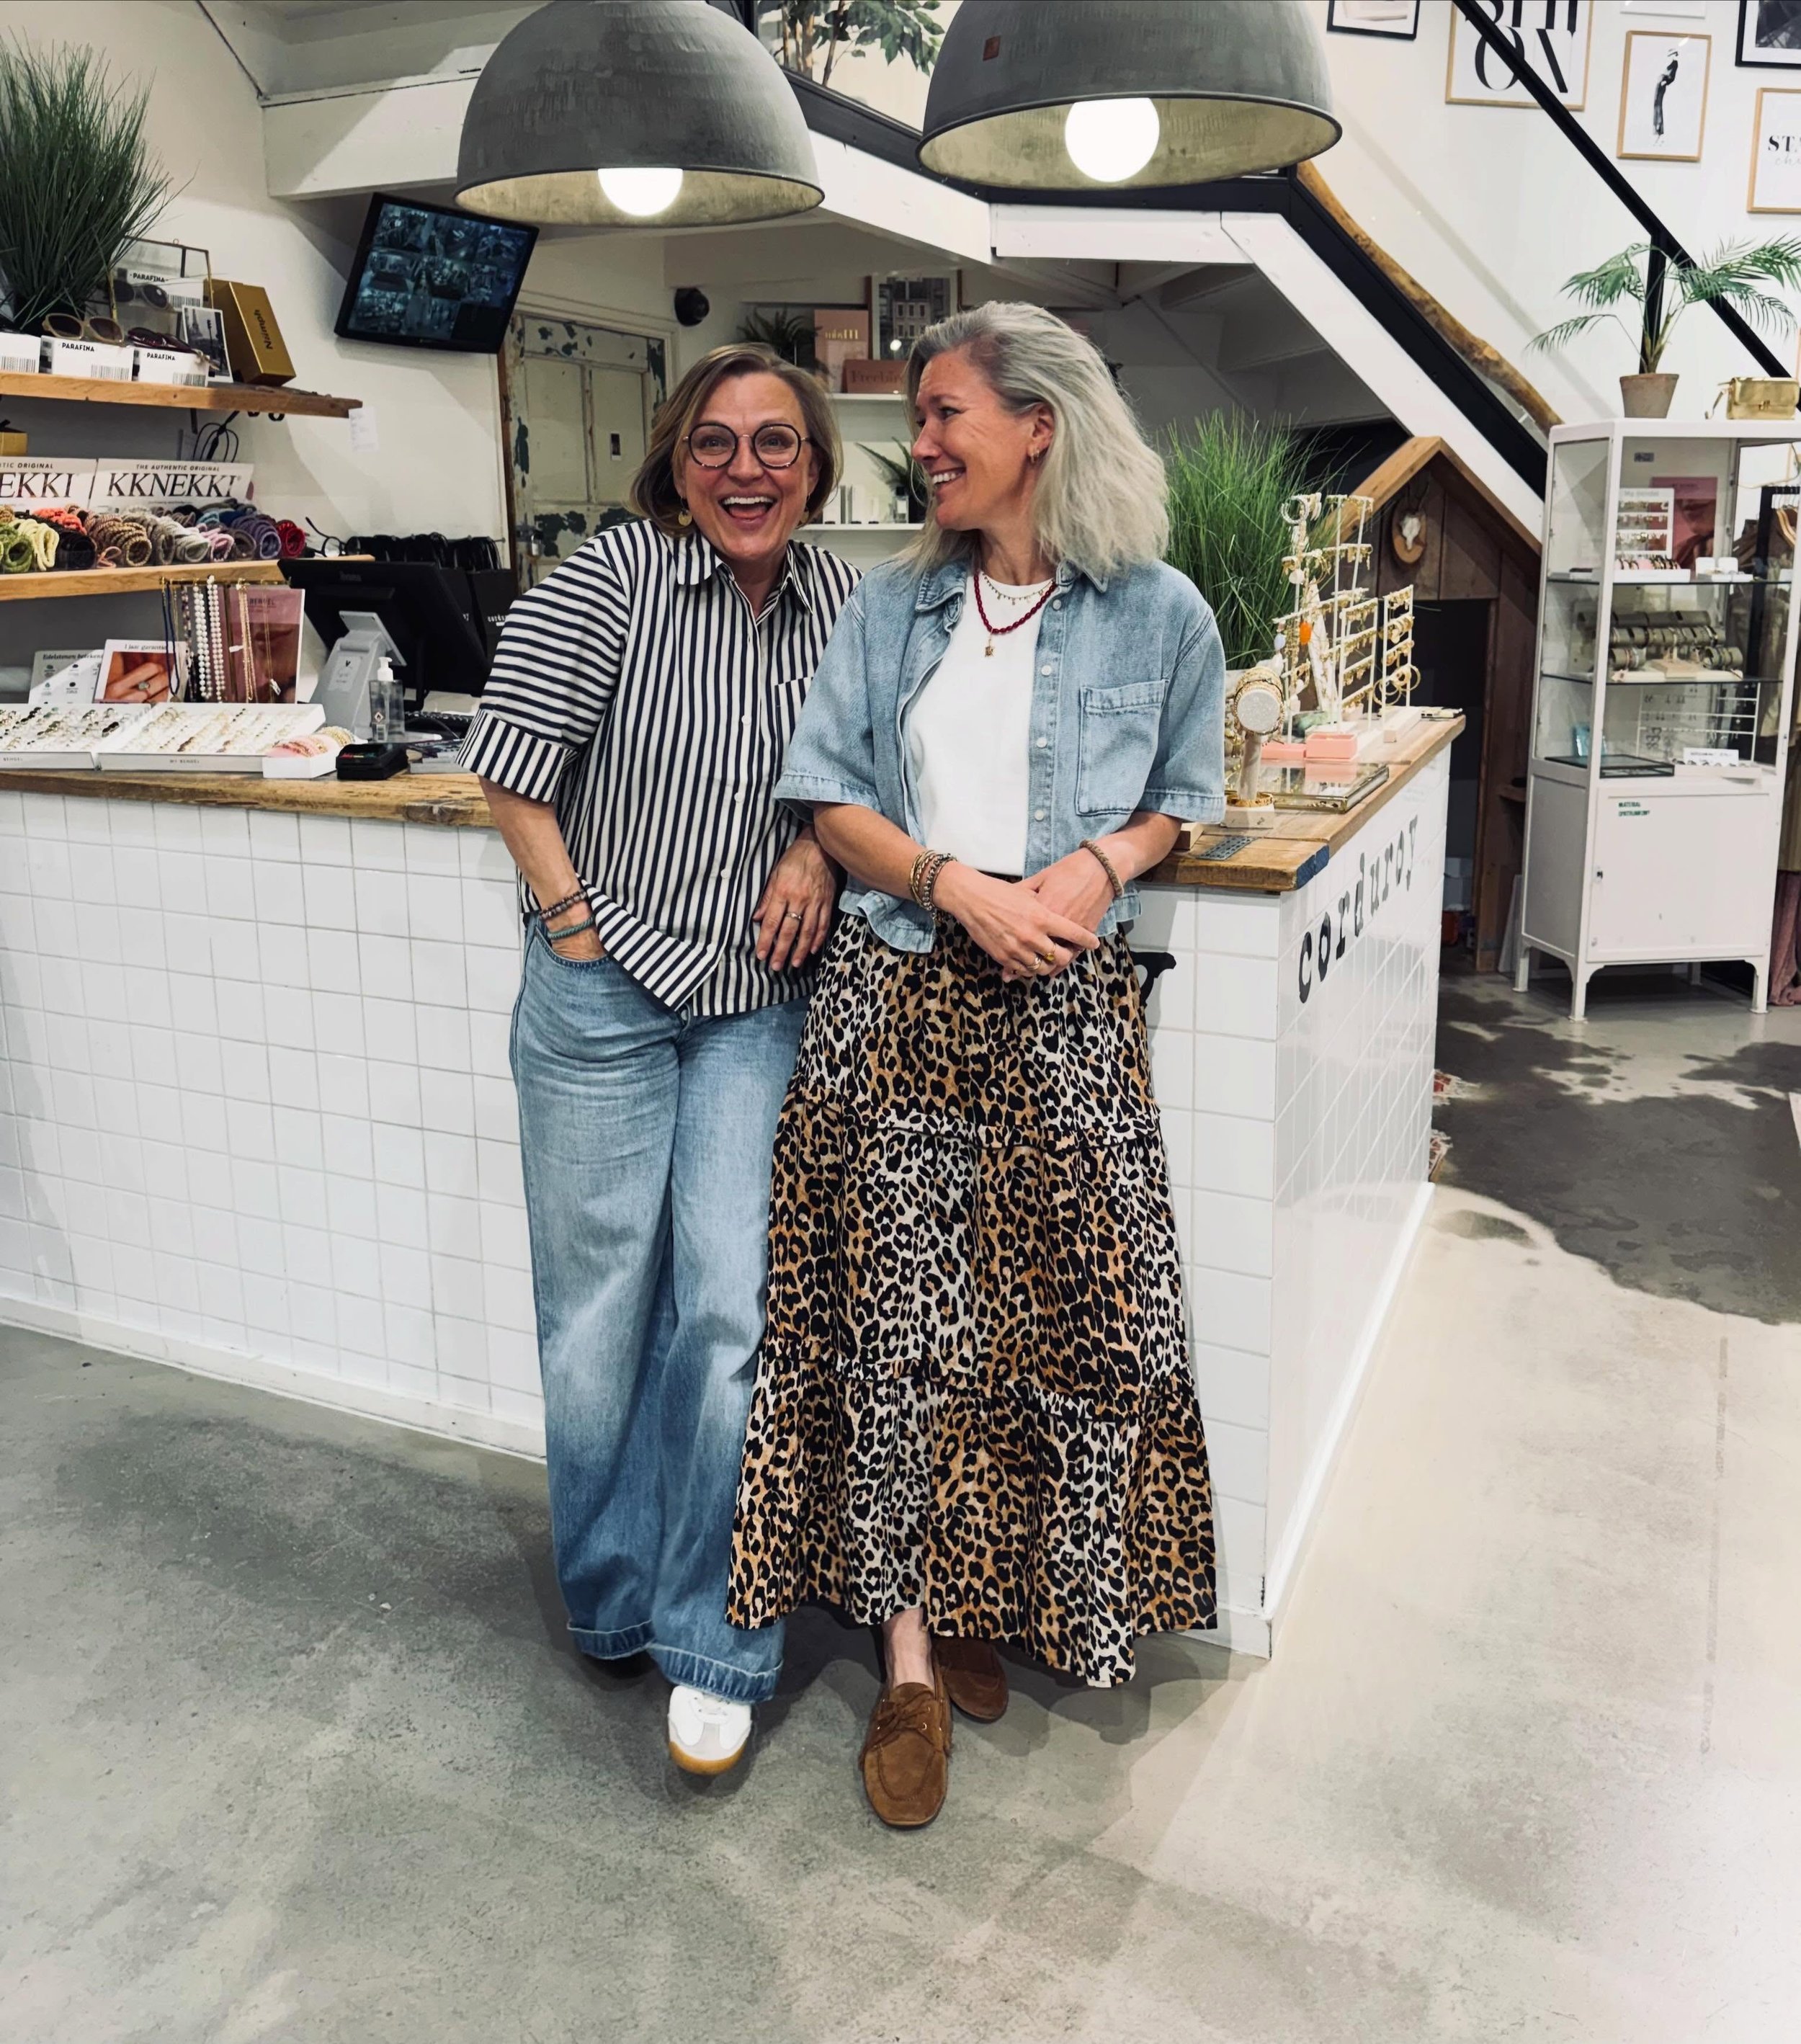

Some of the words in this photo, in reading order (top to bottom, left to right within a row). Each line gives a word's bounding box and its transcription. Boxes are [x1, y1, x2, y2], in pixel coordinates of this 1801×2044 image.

[1768, 135, 1801, 152] ST
[133, 272, 165, 282] PARAFINA
[61, 342, 95, 352] PARAFINA
[146, 352, 176, 361] PARAFINA
[107, 473, 236, 498] KKNEKKI
[1298, 814, 1418, 1004] corduroy
